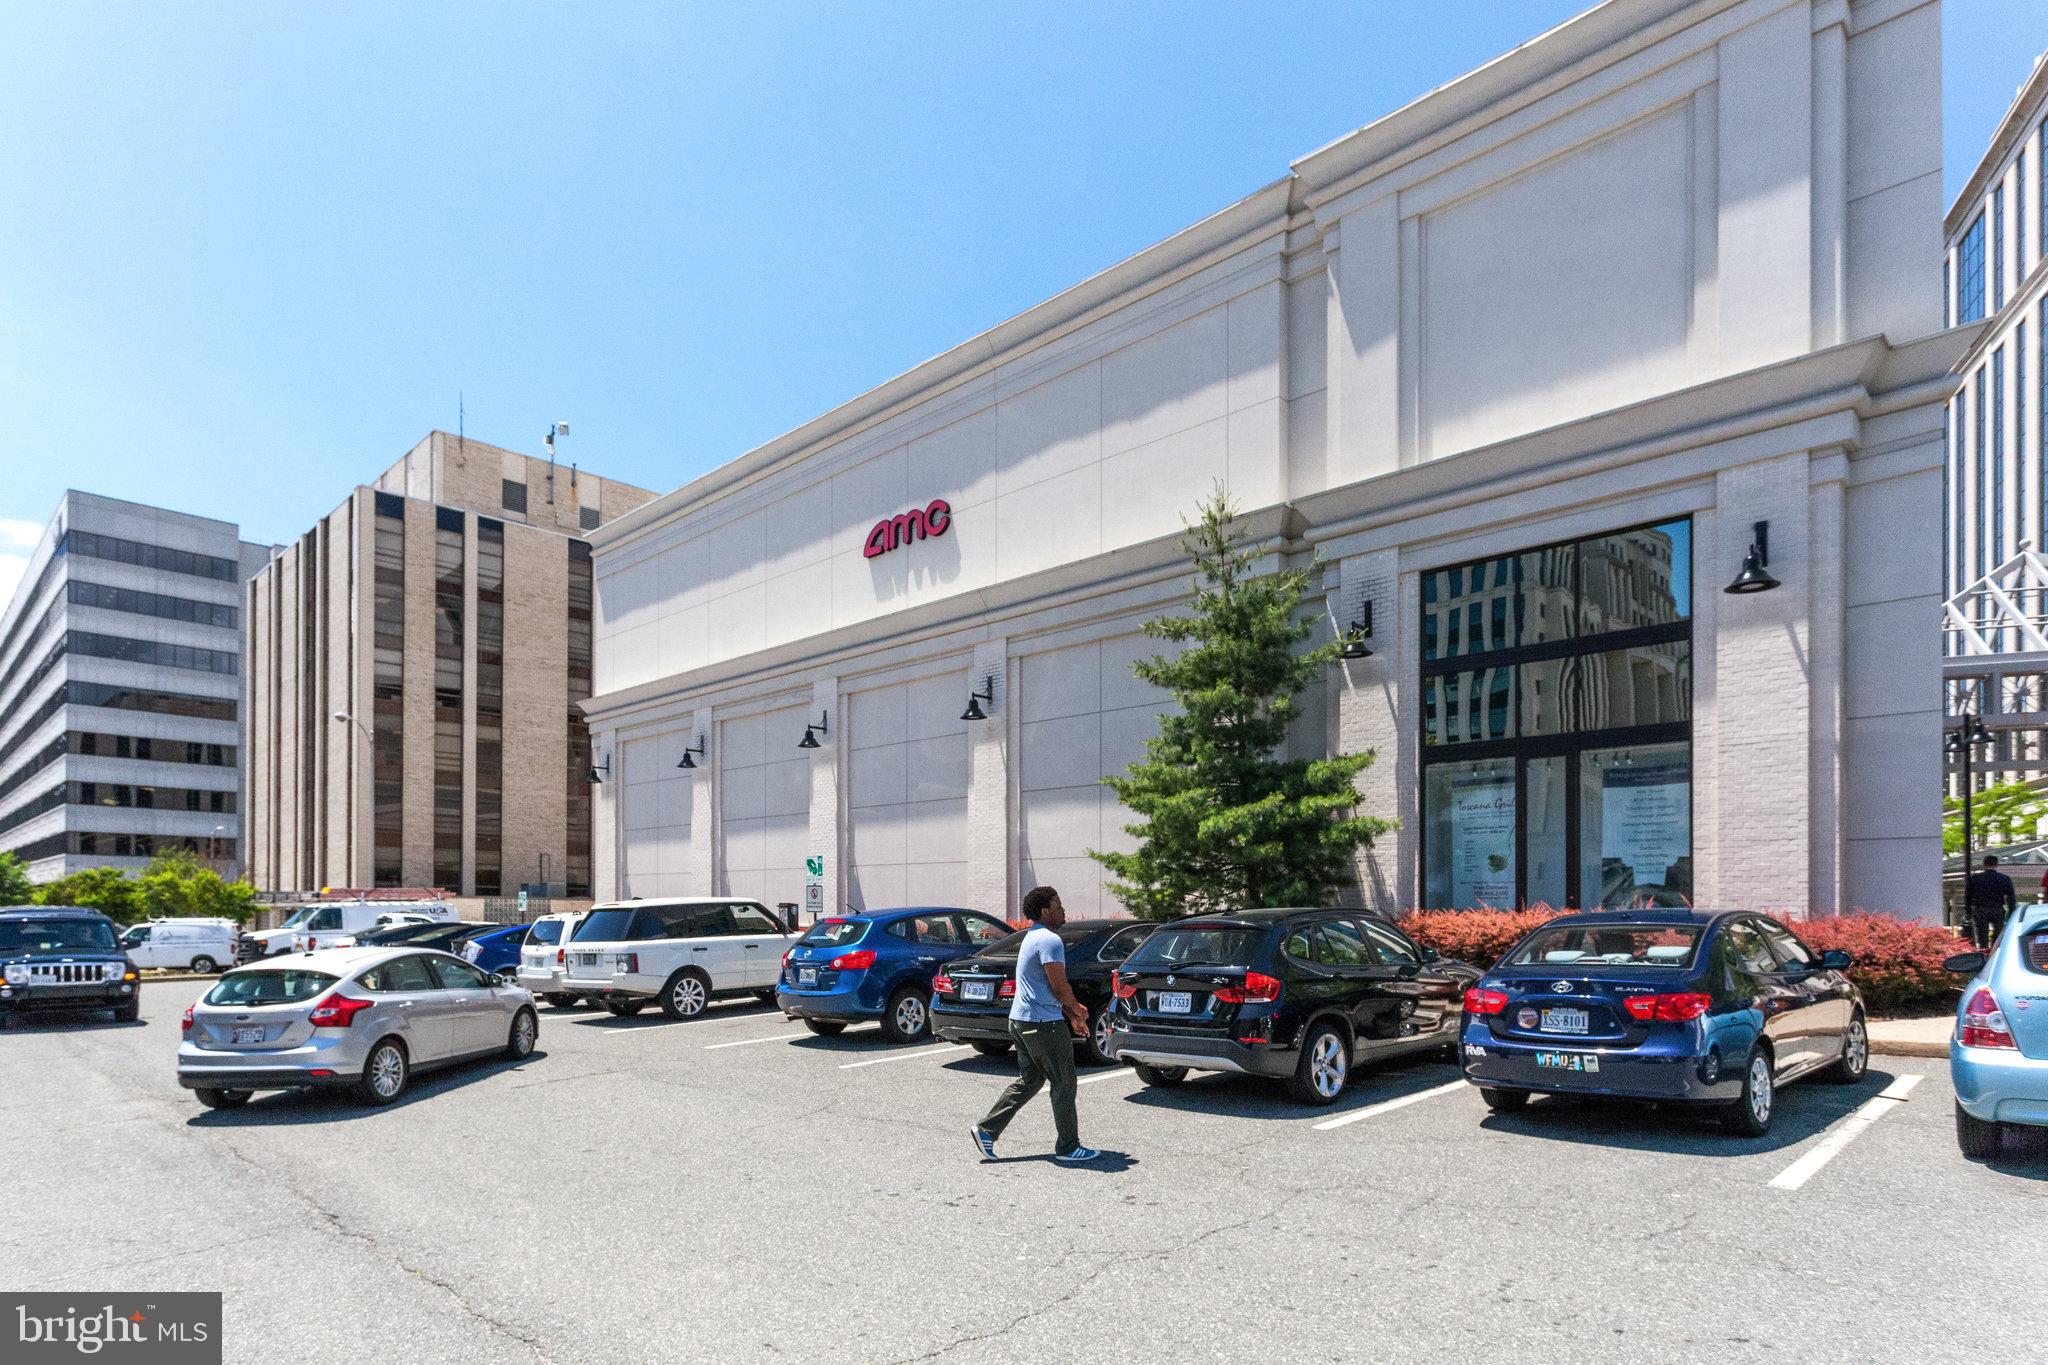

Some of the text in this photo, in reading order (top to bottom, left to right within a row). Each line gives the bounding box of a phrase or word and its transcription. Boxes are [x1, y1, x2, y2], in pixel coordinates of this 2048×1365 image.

[1458, 797, 1516, 811] Toscana Gril
[1543, 1014, 1586, 1027] XSS-8101
[1465, 1046, 1486, 1056] RVA
[1536, 1052, 1569, 1067] WFMU
